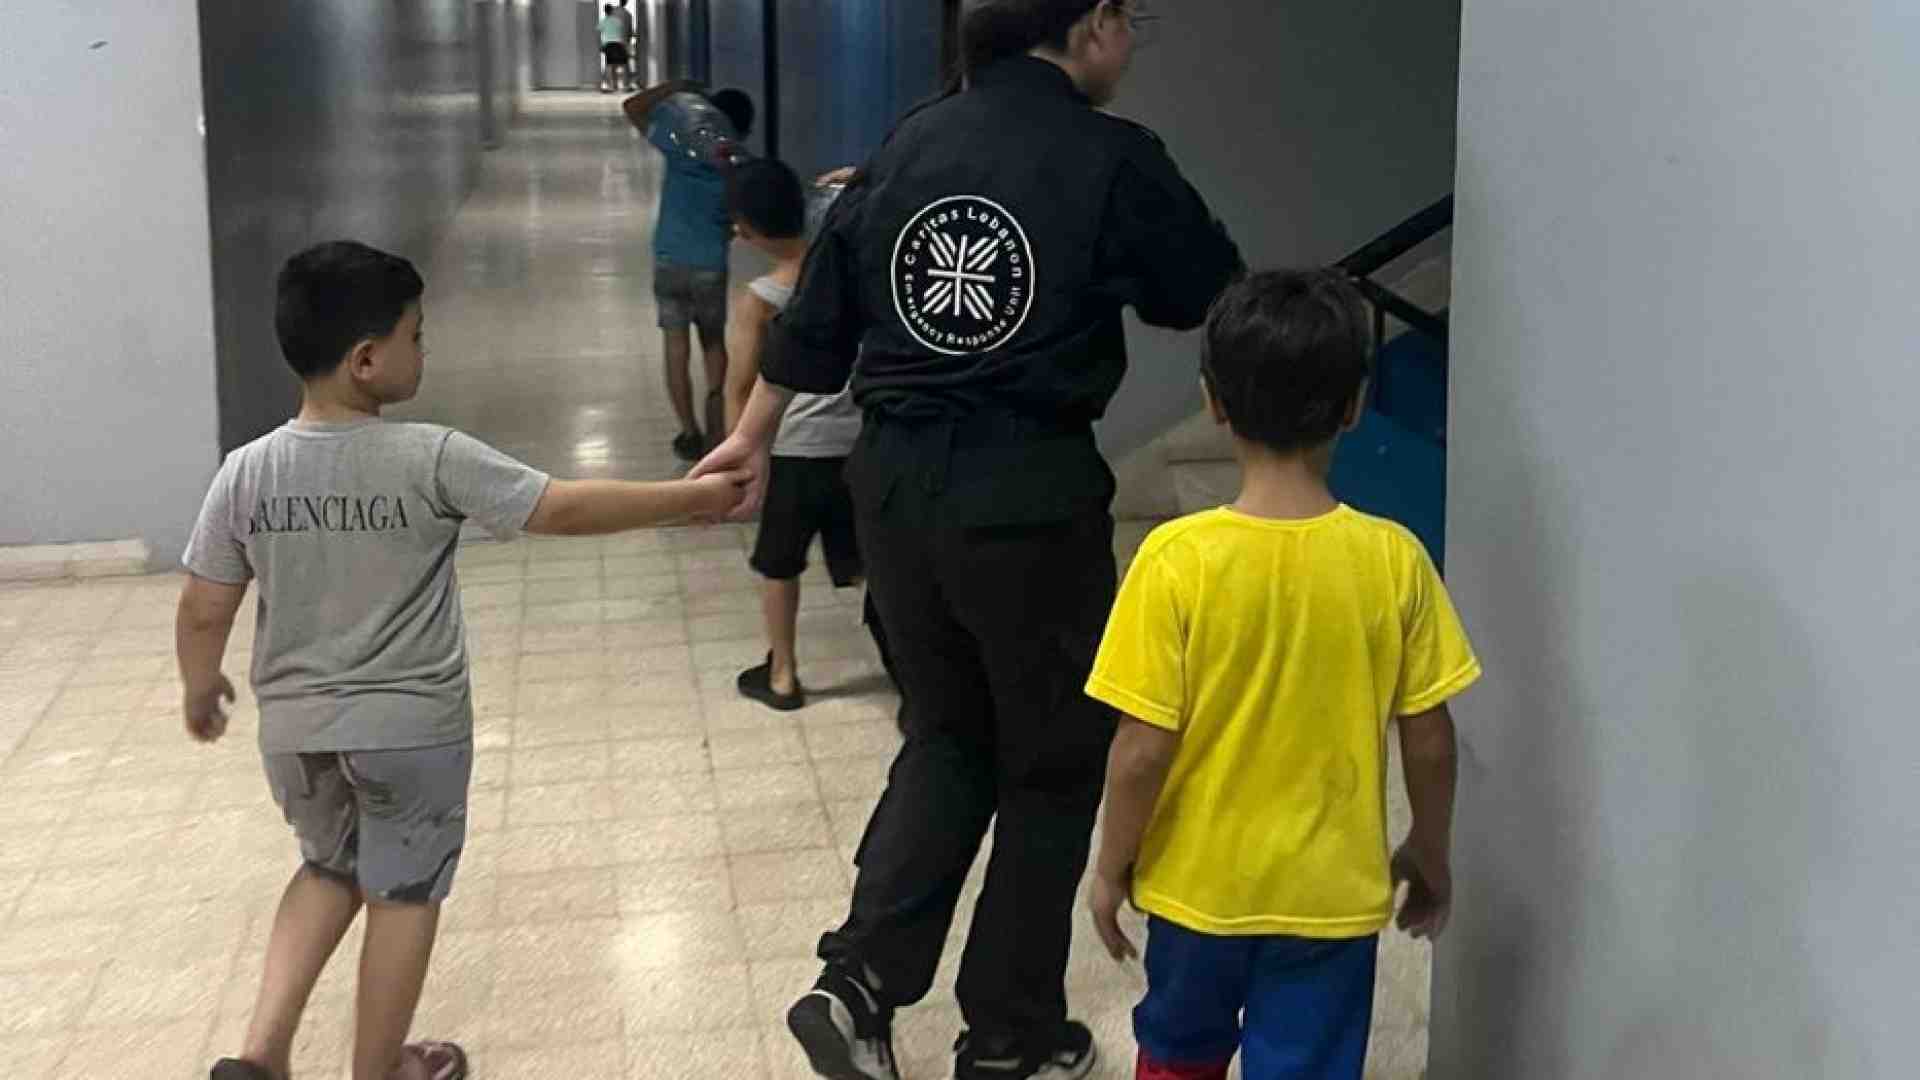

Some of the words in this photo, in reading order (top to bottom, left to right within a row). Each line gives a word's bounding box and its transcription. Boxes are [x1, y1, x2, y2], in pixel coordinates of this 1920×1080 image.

[904, 208, 959, 266] Caritas
[967, 207, 1022, 278] Lebanon
[946, 319, 1007, 346] Response
